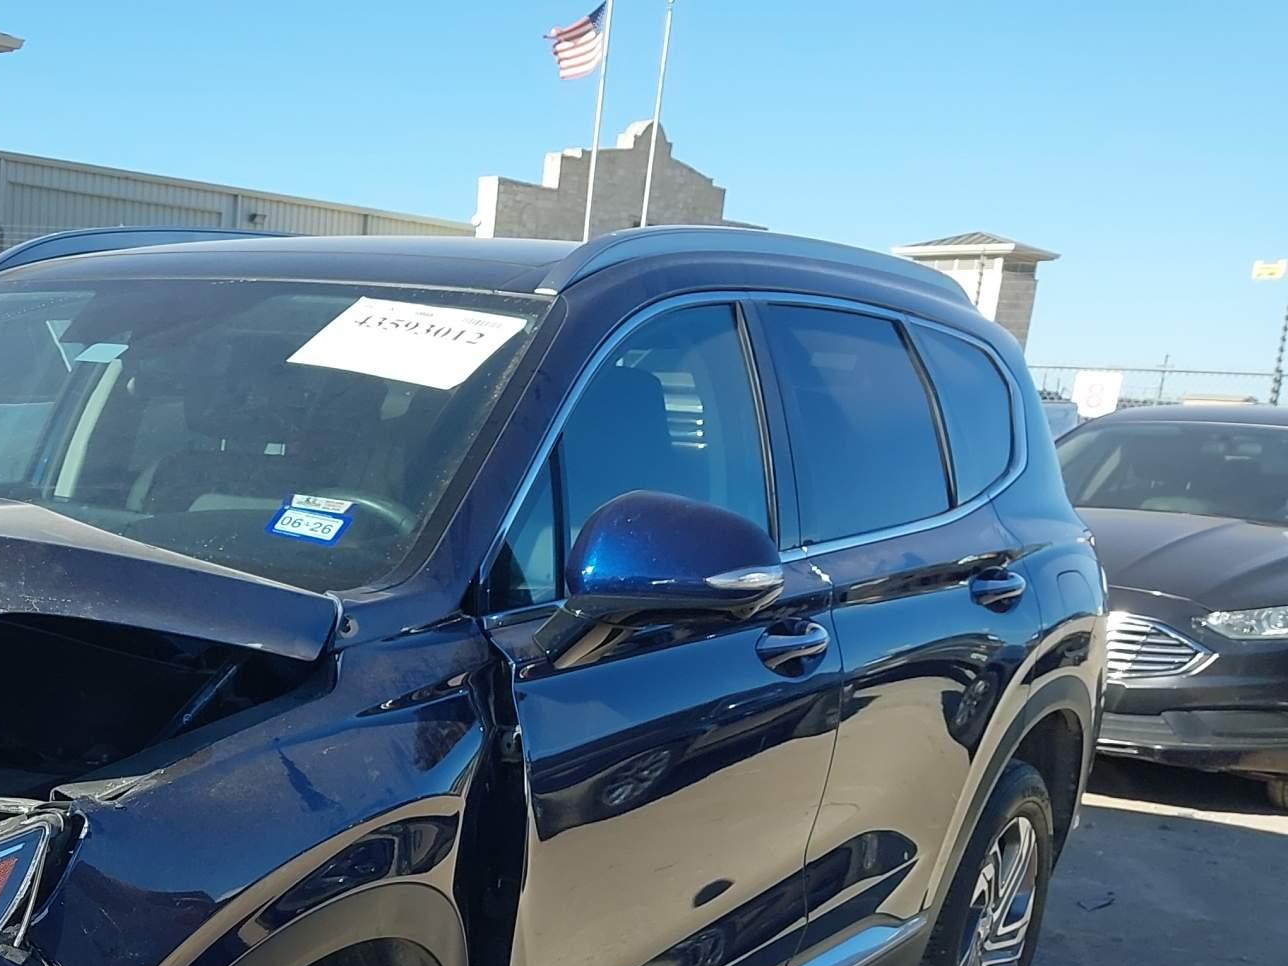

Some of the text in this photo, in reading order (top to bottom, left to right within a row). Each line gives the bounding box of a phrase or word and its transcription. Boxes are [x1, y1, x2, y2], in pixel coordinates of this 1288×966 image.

[353, 314, 486, 346] 43593012
[280, 515, 303, 529] 06
[309, 521, 334, 535] 26
